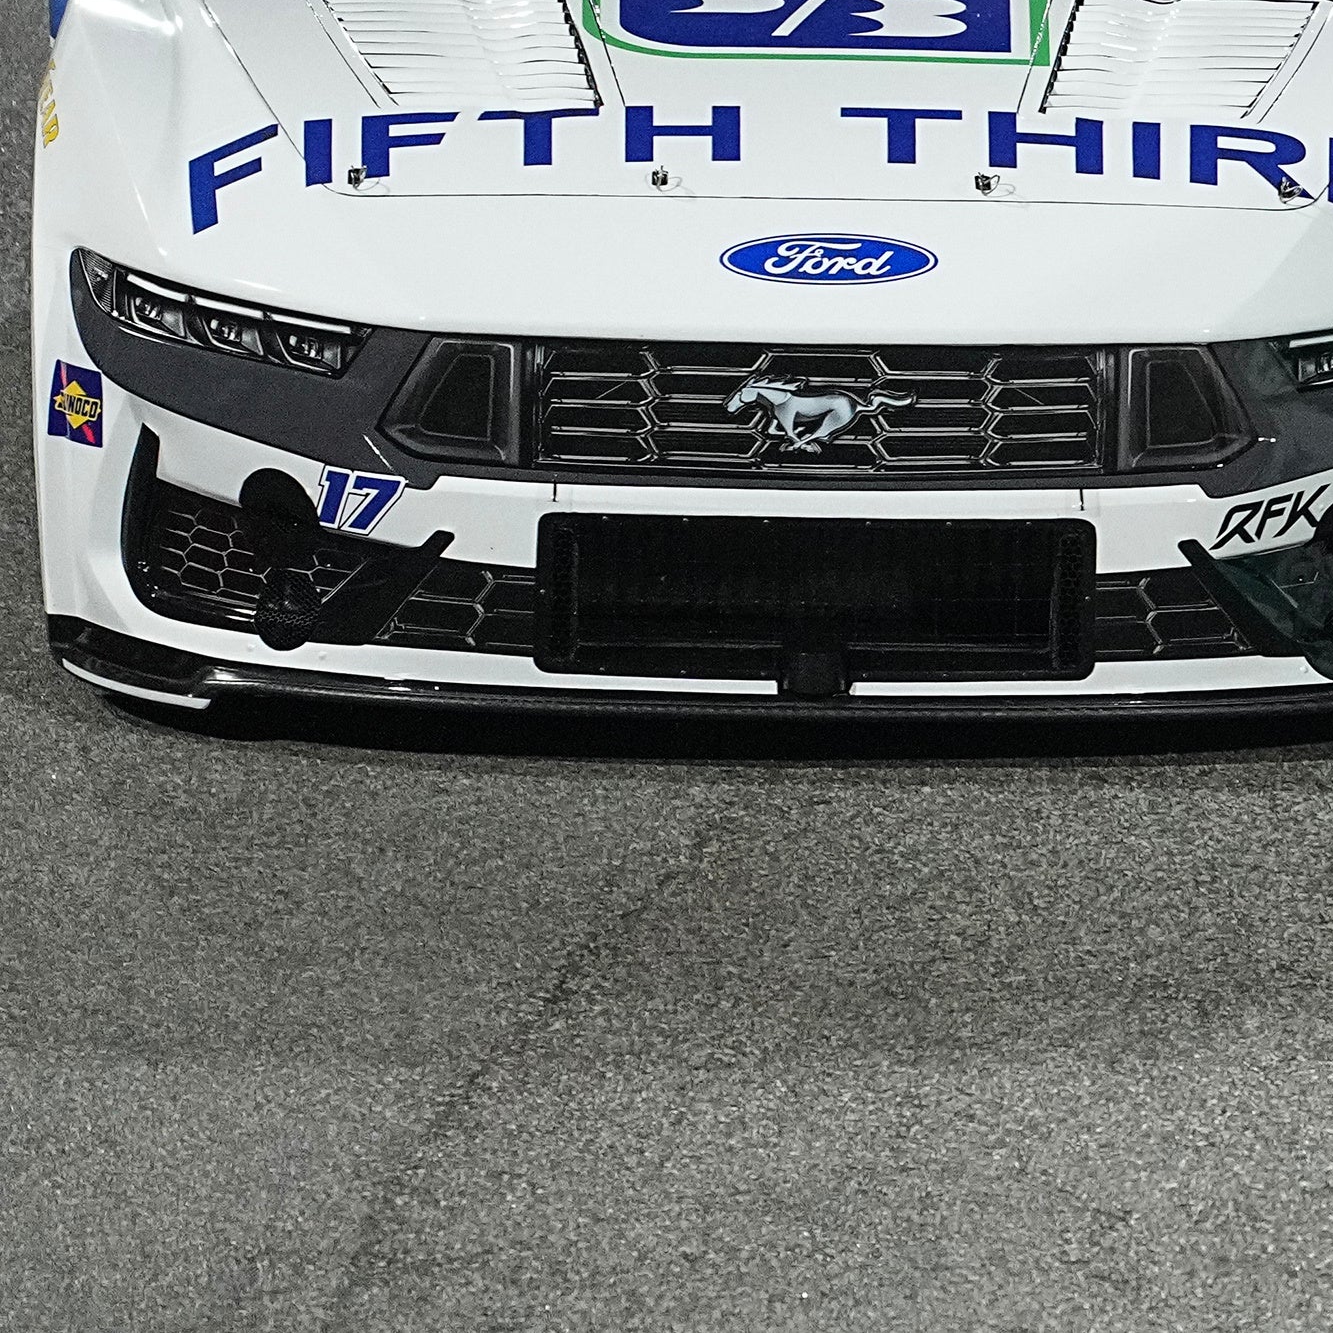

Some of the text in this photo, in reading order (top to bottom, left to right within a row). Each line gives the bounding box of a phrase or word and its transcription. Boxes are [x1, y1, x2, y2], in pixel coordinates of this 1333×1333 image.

[188, 105, 742, 235] FIFTH
[317, 465, 405, 536] 17
[1206, 484, 1332, 550] RFK
